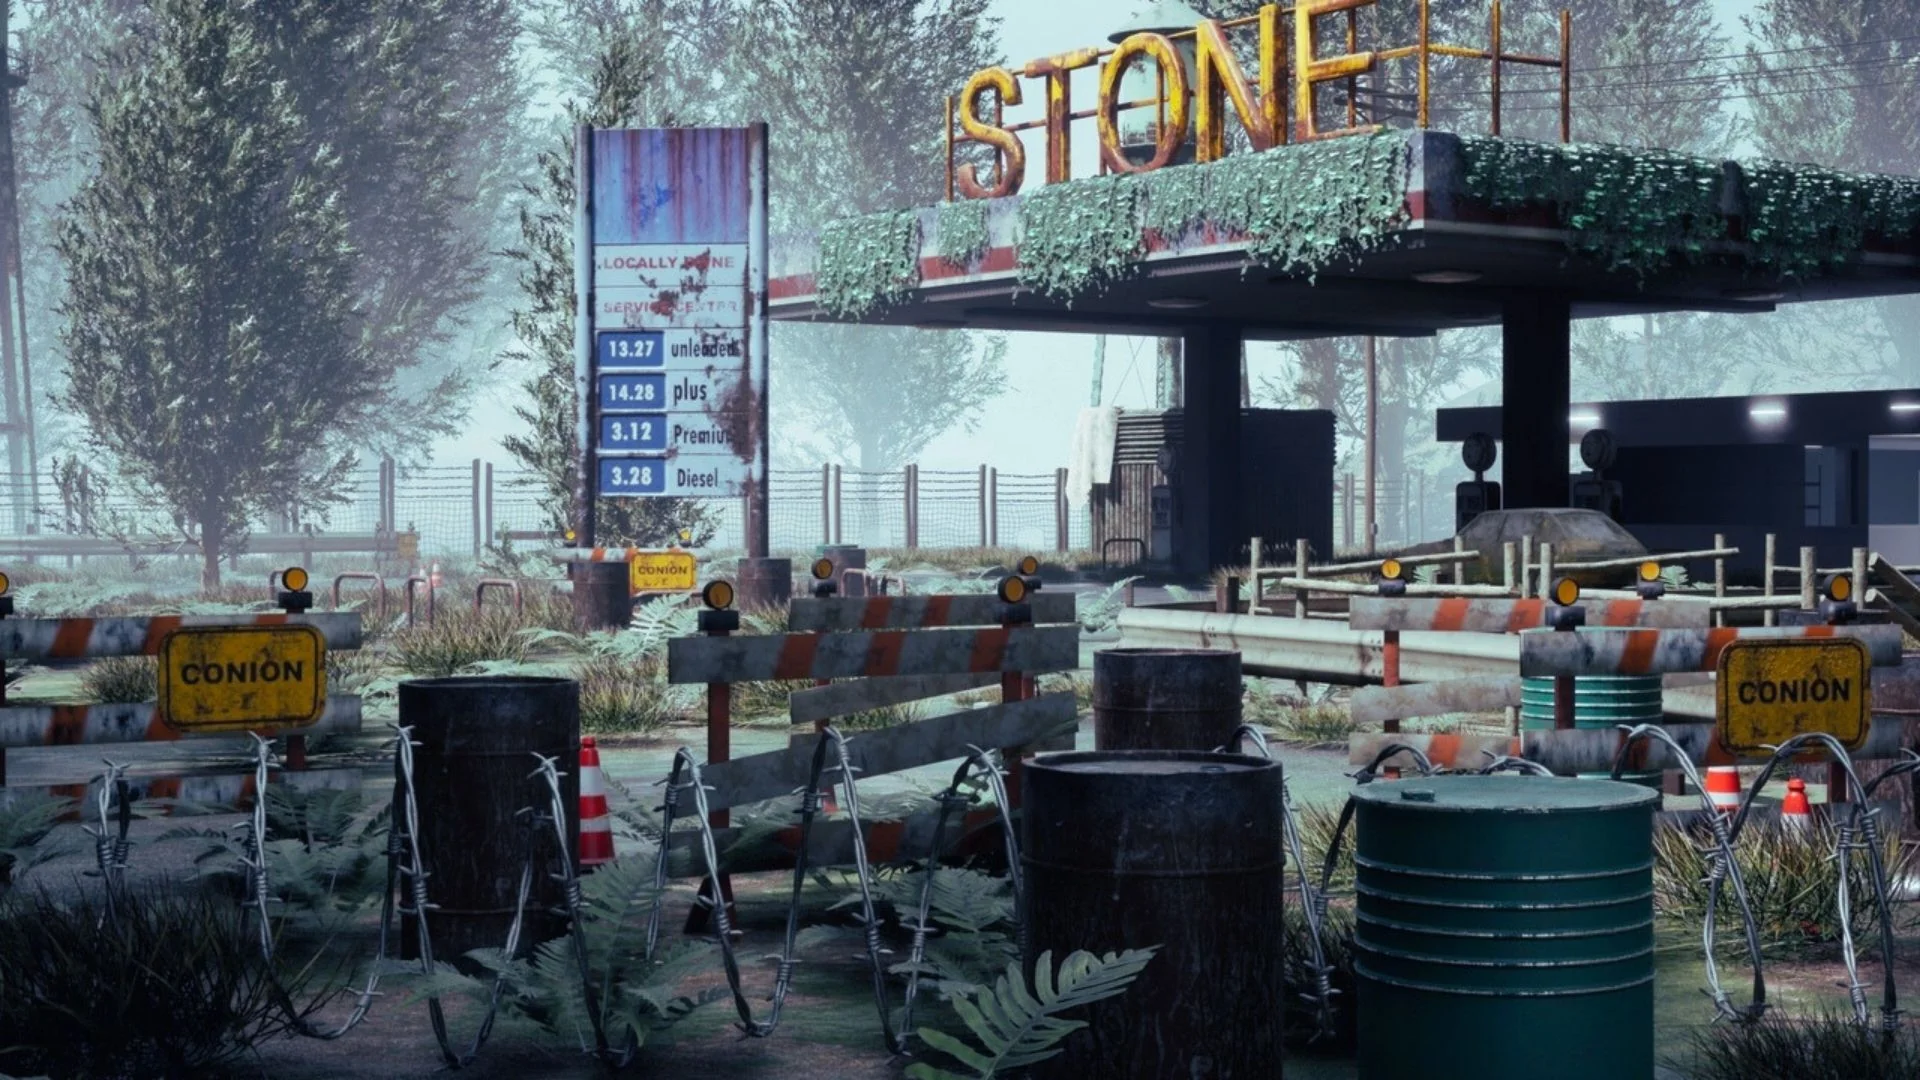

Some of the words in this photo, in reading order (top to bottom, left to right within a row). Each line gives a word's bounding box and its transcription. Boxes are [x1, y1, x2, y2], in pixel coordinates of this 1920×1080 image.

[957, 0, 1384, 200] STONE
[603, 256, 678, 269] LOCALLY
[603, 301, 672, 313] SERVI
[608, 340, 655, 358] 13.27
[608, 384, 655, 401] 14.28
[673, 376, 708, 406] plus
[611, 422, 652, 441] 3.12
[674, 424, 730, 444] Premiu
[611, 466, 652, 486] 3.28
[677, 467, 719, 487] Diesel
[638, 565, 687, 575] CONION
[181, 661, 303, 684] CONION
[1738, 678, 1850, 704] CONION
